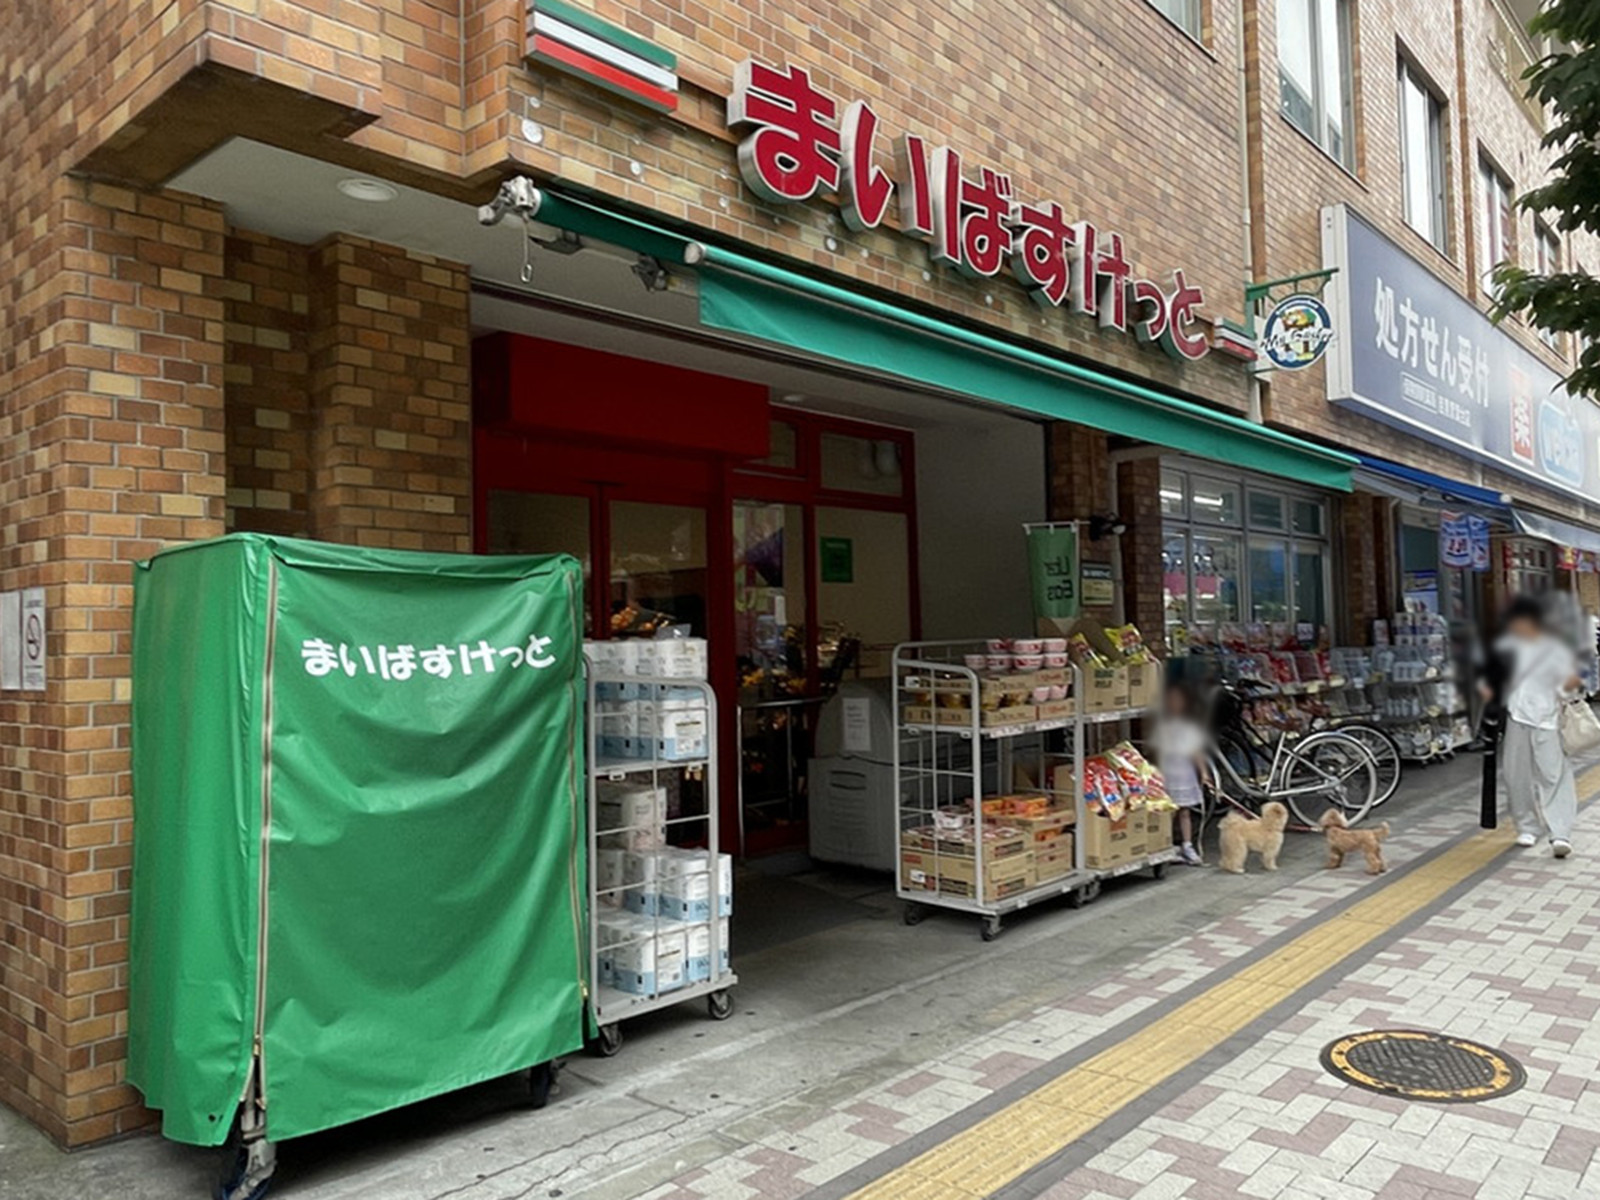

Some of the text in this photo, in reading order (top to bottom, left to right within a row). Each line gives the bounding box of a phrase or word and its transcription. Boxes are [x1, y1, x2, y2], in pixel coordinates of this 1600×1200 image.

[728, 57, 1210, 362] まいばすけっと
[1374, 276, 1490, 408] 処方せん受付
[301, 635, 555, 681] まいばすけっと
